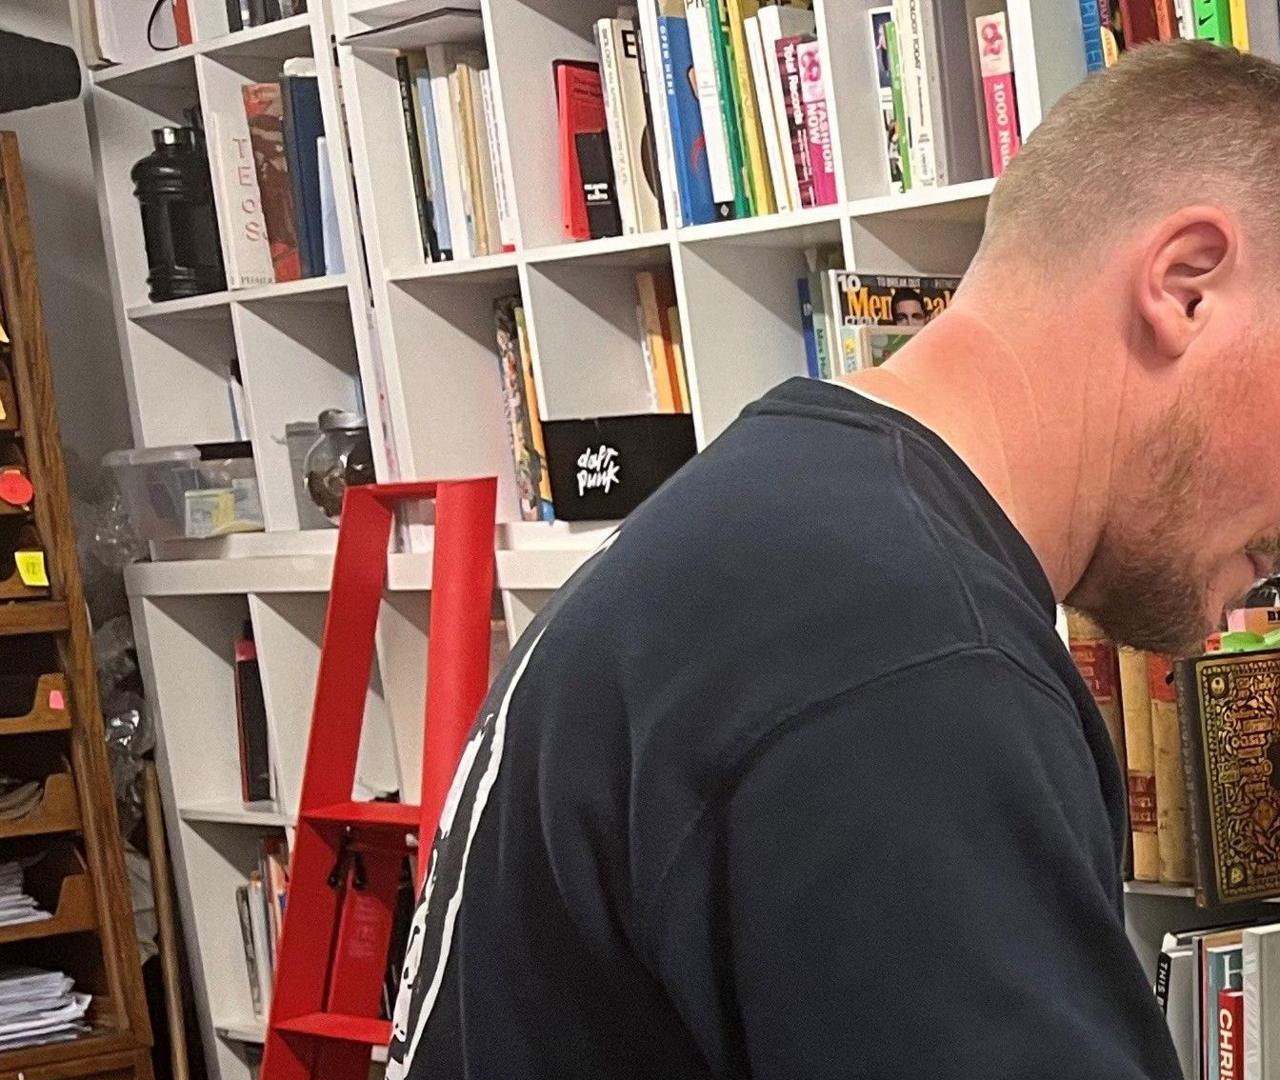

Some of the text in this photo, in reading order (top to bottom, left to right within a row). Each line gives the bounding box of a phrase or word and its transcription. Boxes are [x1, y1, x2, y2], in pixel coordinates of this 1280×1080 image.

[659, 25, 675, 96] OPEN HERE
[783, 42, 804, 126] Total Records
[994, 82, 1008, 125] 1000
[807, 102, 823, 144] NOW
[819, 101, 834, 174] FASHION
[837, 275, 861, 293] 10
[576, 461, 621, 497] punk
[577, 445, 619, 472] daft
[1158, 961, 1169, 994] THIS
